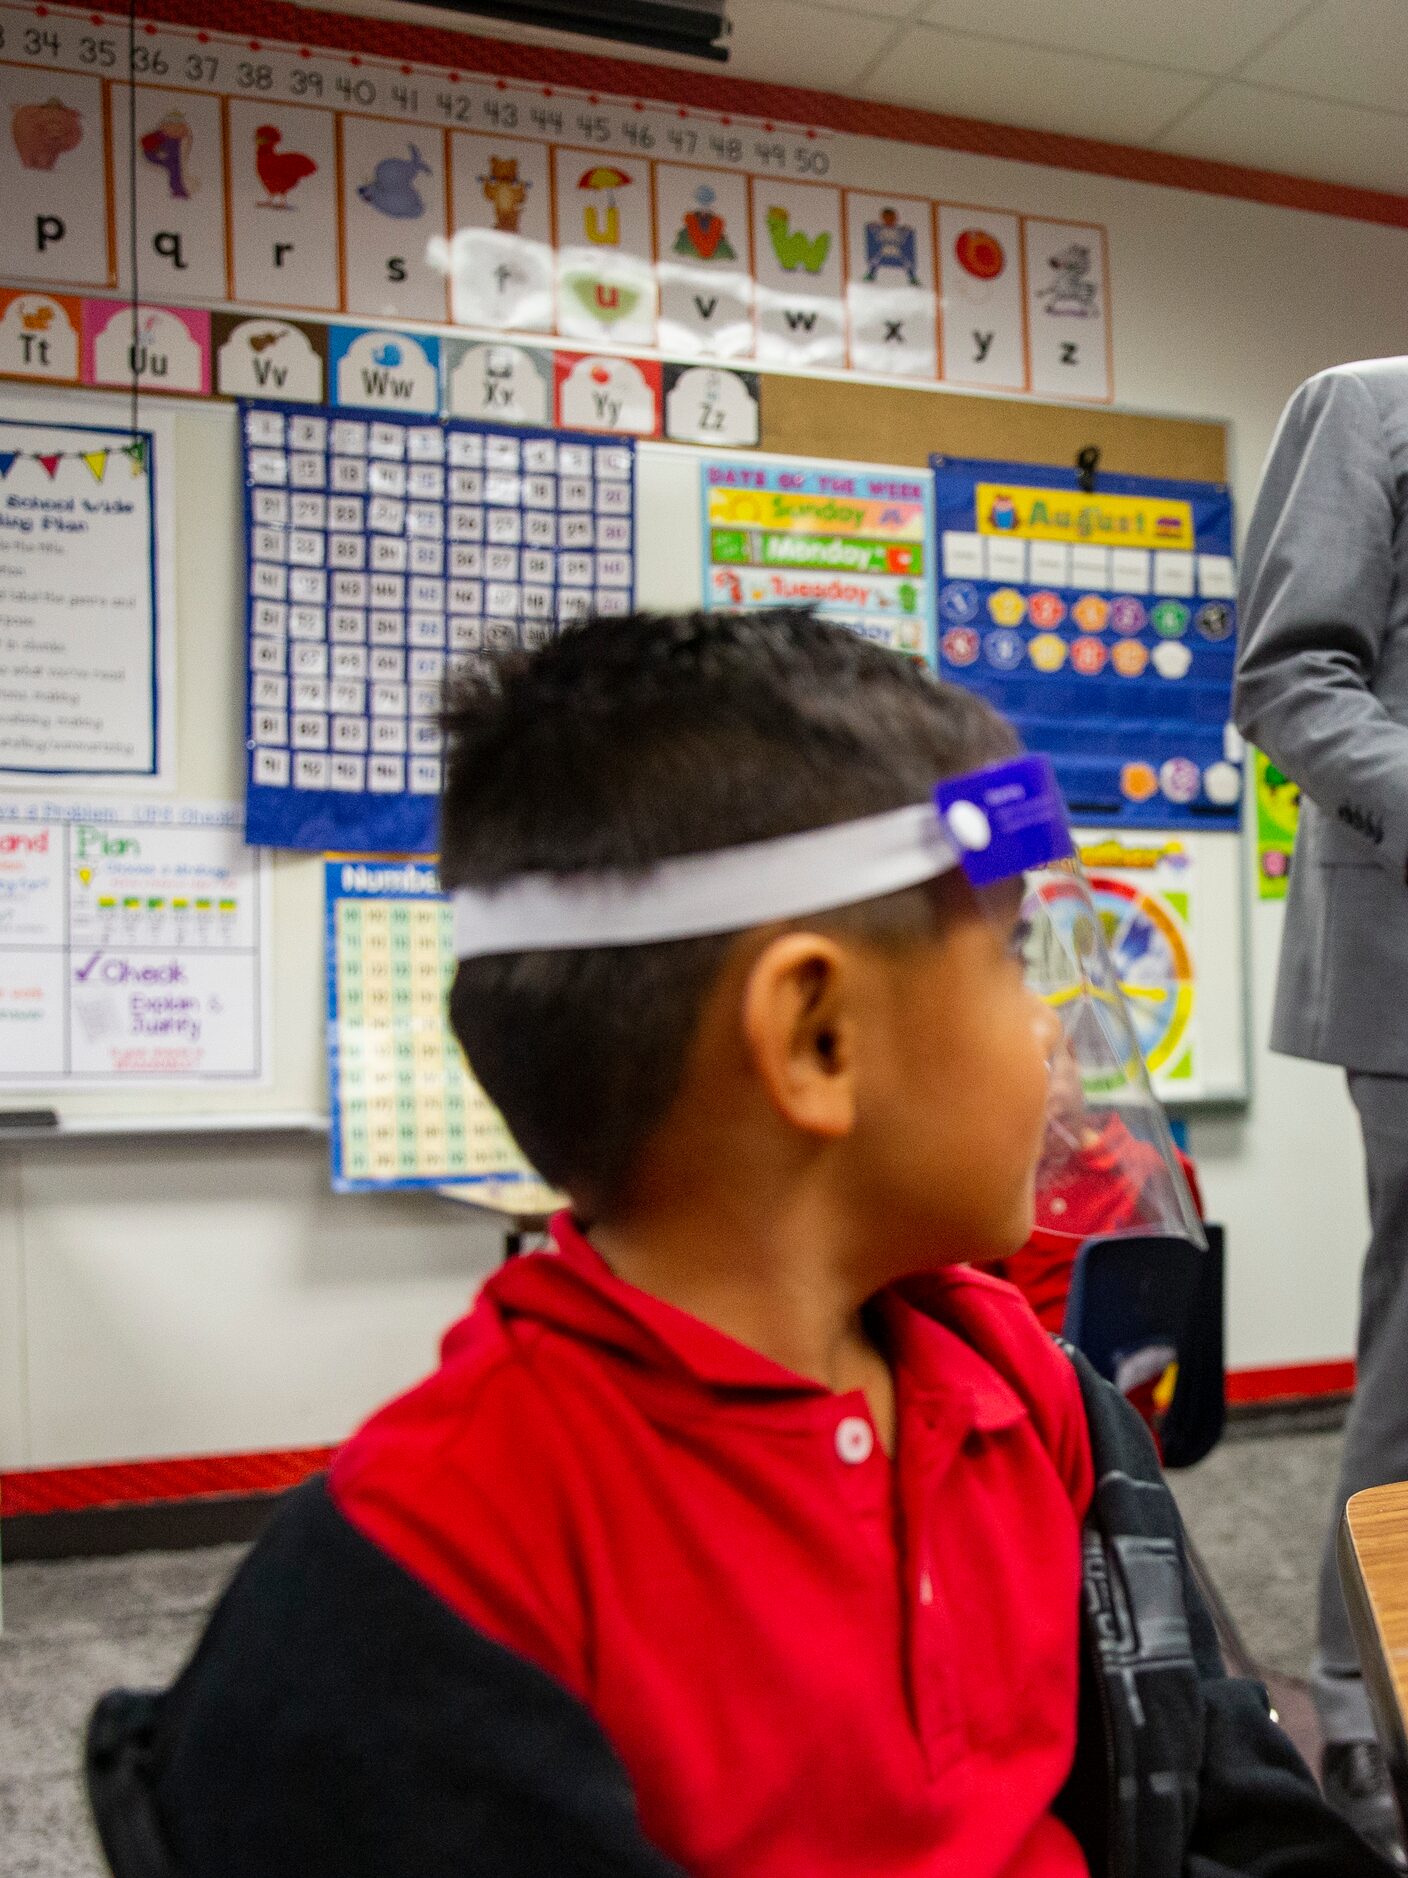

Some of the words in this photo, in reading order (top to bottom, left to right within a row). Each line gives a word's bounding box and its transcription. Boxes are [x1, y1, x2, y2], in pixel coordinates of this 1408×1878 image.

[24, 28, 61, 57] 34
[79, 36, 116, 67] 35
[132, 46, 169, 76] 36
[185, 53, 219, 83] 37
[237, 61, 274, 91] 38
[290, 69, 324, 99] 39
[335, 76, 377, 105] 40
[391, 85, 419, 111] 41
[437, 93, 472, 122] 42
[484, 98, 519, 128] 43
[531, 106, 563, 133] 44
[576, 111, 611, 142] 45
[622, 121, 656, 149] 46
[667, 128, 698, 155] 47
[709, 134, 743, 163] 48
[754, 141, 787, 168] 49
[794, 147, 830, 175] 50
[36, 214, 66, 252] p
[154, 231, 188, 270] q
[274, 241, 294, 267] r
[387, 256, 408, 283] s
[595, 284, 620, 308] u
[693, 296, 719, 320] v
[785, 310, 817, 332] w
[884, 319, 904, 343] x
[18, 333, 51, 367] Tt
[131, 343, 168, 377] Uu
[973, 330, 994, 363] y
[1060, 341, 1079, 366] z
[253, 357, 288, 388] Vv
[362, 368, 414, 400] Ww
[483, 382, 514, 406] Xx
[591, 388, 623, 429] Yy
[696, 402, 726, 432] Zz
[707, 466, 766, 488] DAYS
[818, 476, 854, 494] THE
[867, 480, 922, 499] WEEK
[773, 496, 865, 528] Sunday
[1029, 500, 1146, 537] August
[768, 534, 873, 570] Monday
[770, 574, 871, 606] Tuesday
[75, 824, 141, 859] Plan
[341, 864, 441, 893] Numbe
[99, 958, 189, 986] Check
[128, 991, 200, 1014] Explain
